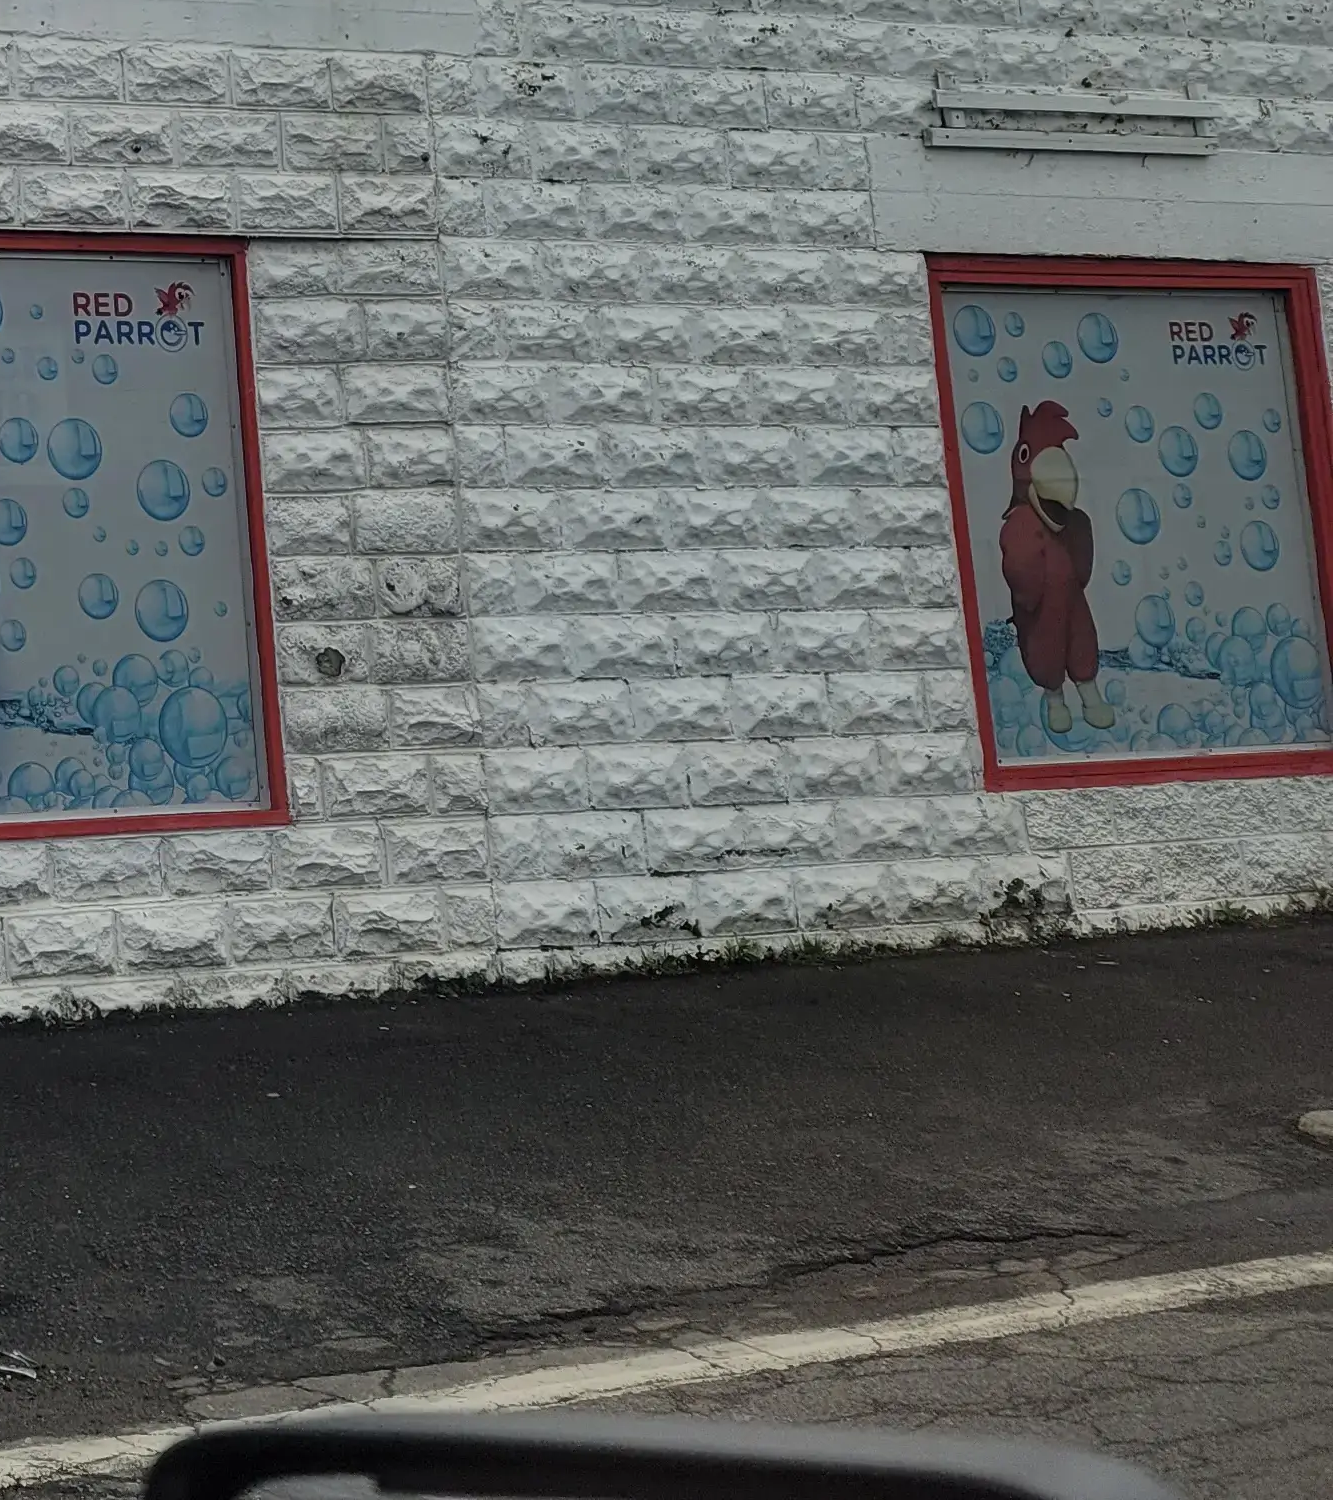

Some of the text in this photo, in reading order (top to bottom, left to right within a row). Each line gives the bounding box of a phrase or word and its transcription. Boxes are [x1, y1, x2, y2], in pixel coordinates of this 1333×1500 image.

[72, 292, 134, 317] RED
[74, 315, 205, 351] PARROT
[1168, 321, 1214, 342] RED
[1172, 341, 1267, 370] PARROT
